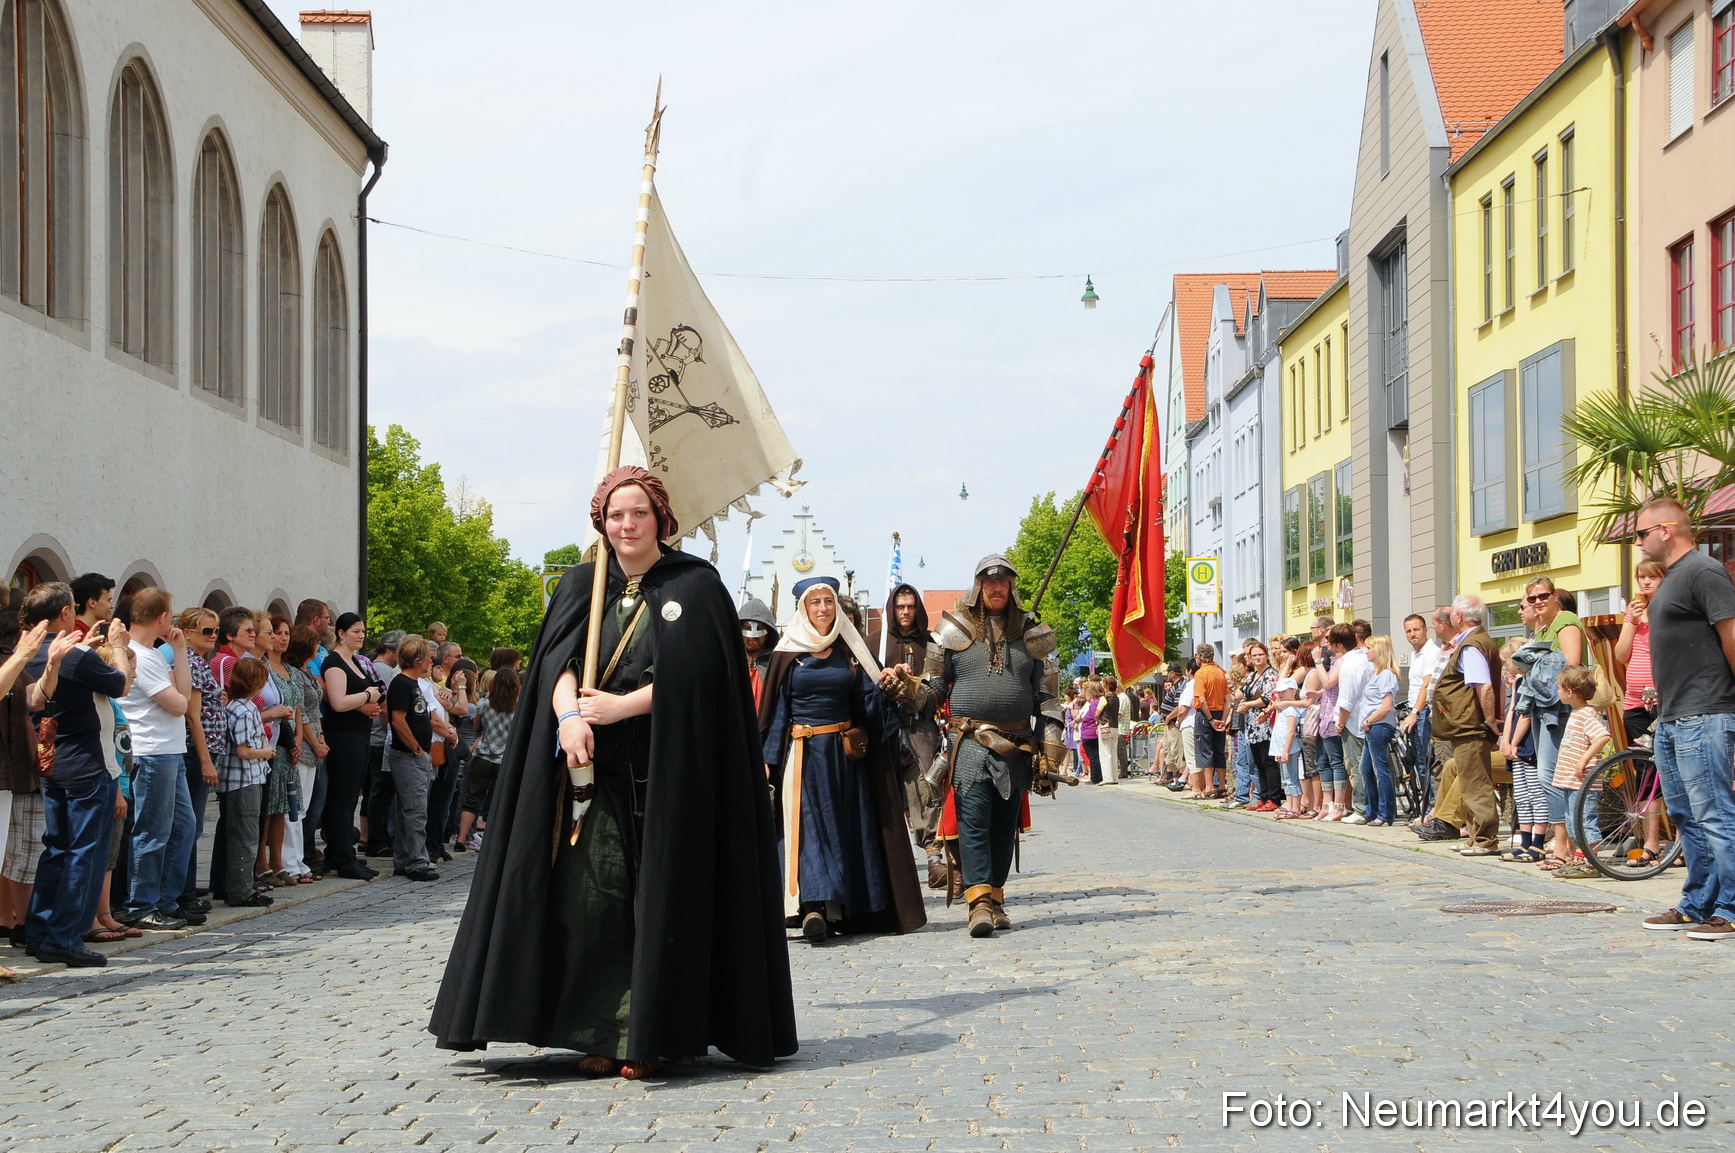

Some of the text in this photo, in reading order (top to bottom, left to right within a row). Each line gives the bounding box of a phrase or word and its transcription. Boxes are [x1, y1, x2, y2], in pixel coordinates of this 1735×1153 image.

[1492, 542, 1548, 574] GERRY WEBER
[1197, 566, 1207, 579] H
